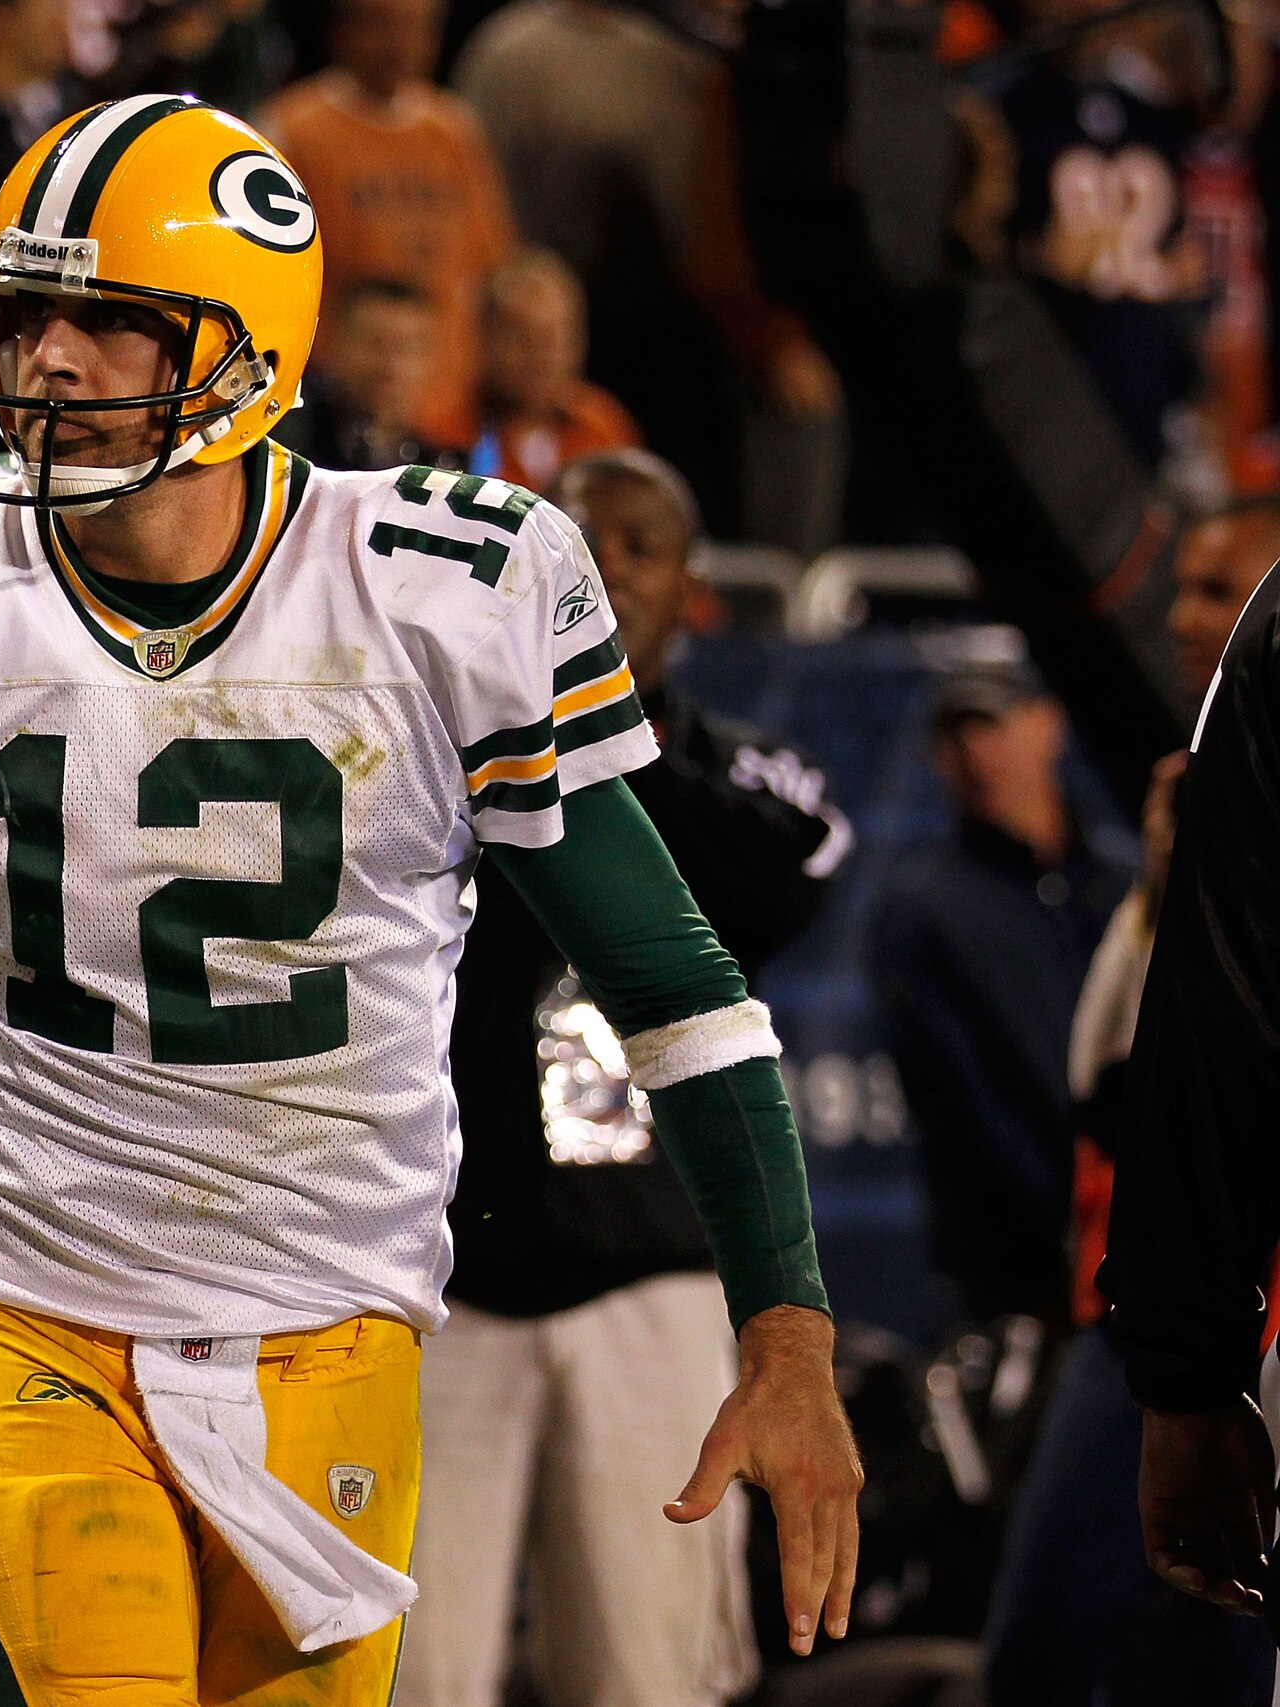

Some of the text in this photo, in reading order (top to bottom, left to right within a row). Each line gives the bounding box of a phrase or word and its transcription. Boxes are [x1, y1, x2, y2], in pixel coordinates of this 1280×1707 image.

[214, 153, 315, 248] G
[368, 464, 543, 589] 12
[149, 652, 173, 668] NFL
[183, 1343, 209, 1358] NFL
